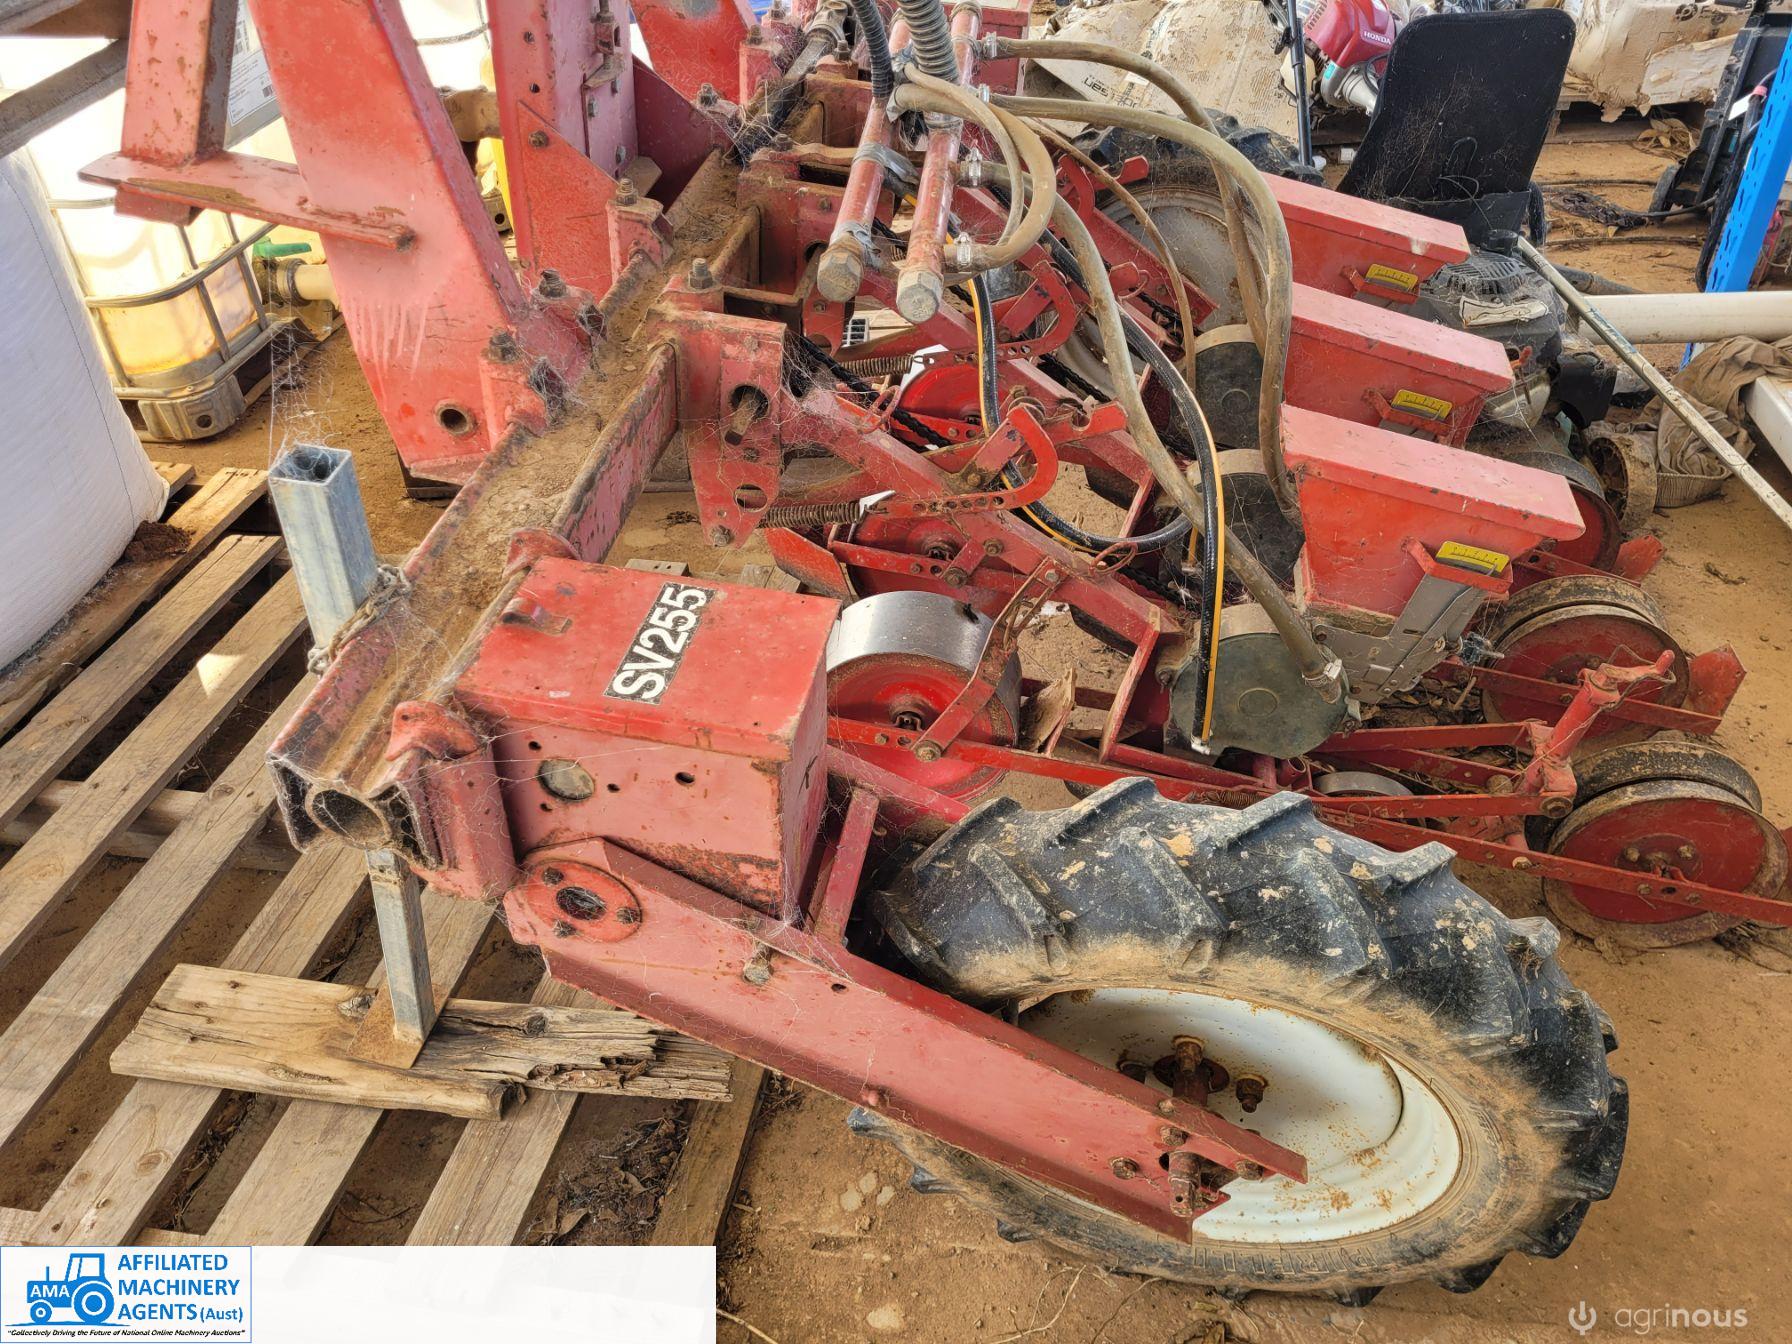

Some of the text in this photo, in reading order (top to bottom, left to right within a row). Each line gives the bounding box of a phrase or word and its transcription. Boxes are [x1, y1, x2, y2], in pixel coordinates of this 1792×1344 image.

[1363, 31, 1392, 45] HONDA
[612, 588, 707, 699] SV255
[1193, 1247, 1378, 1274] PIRELLI
